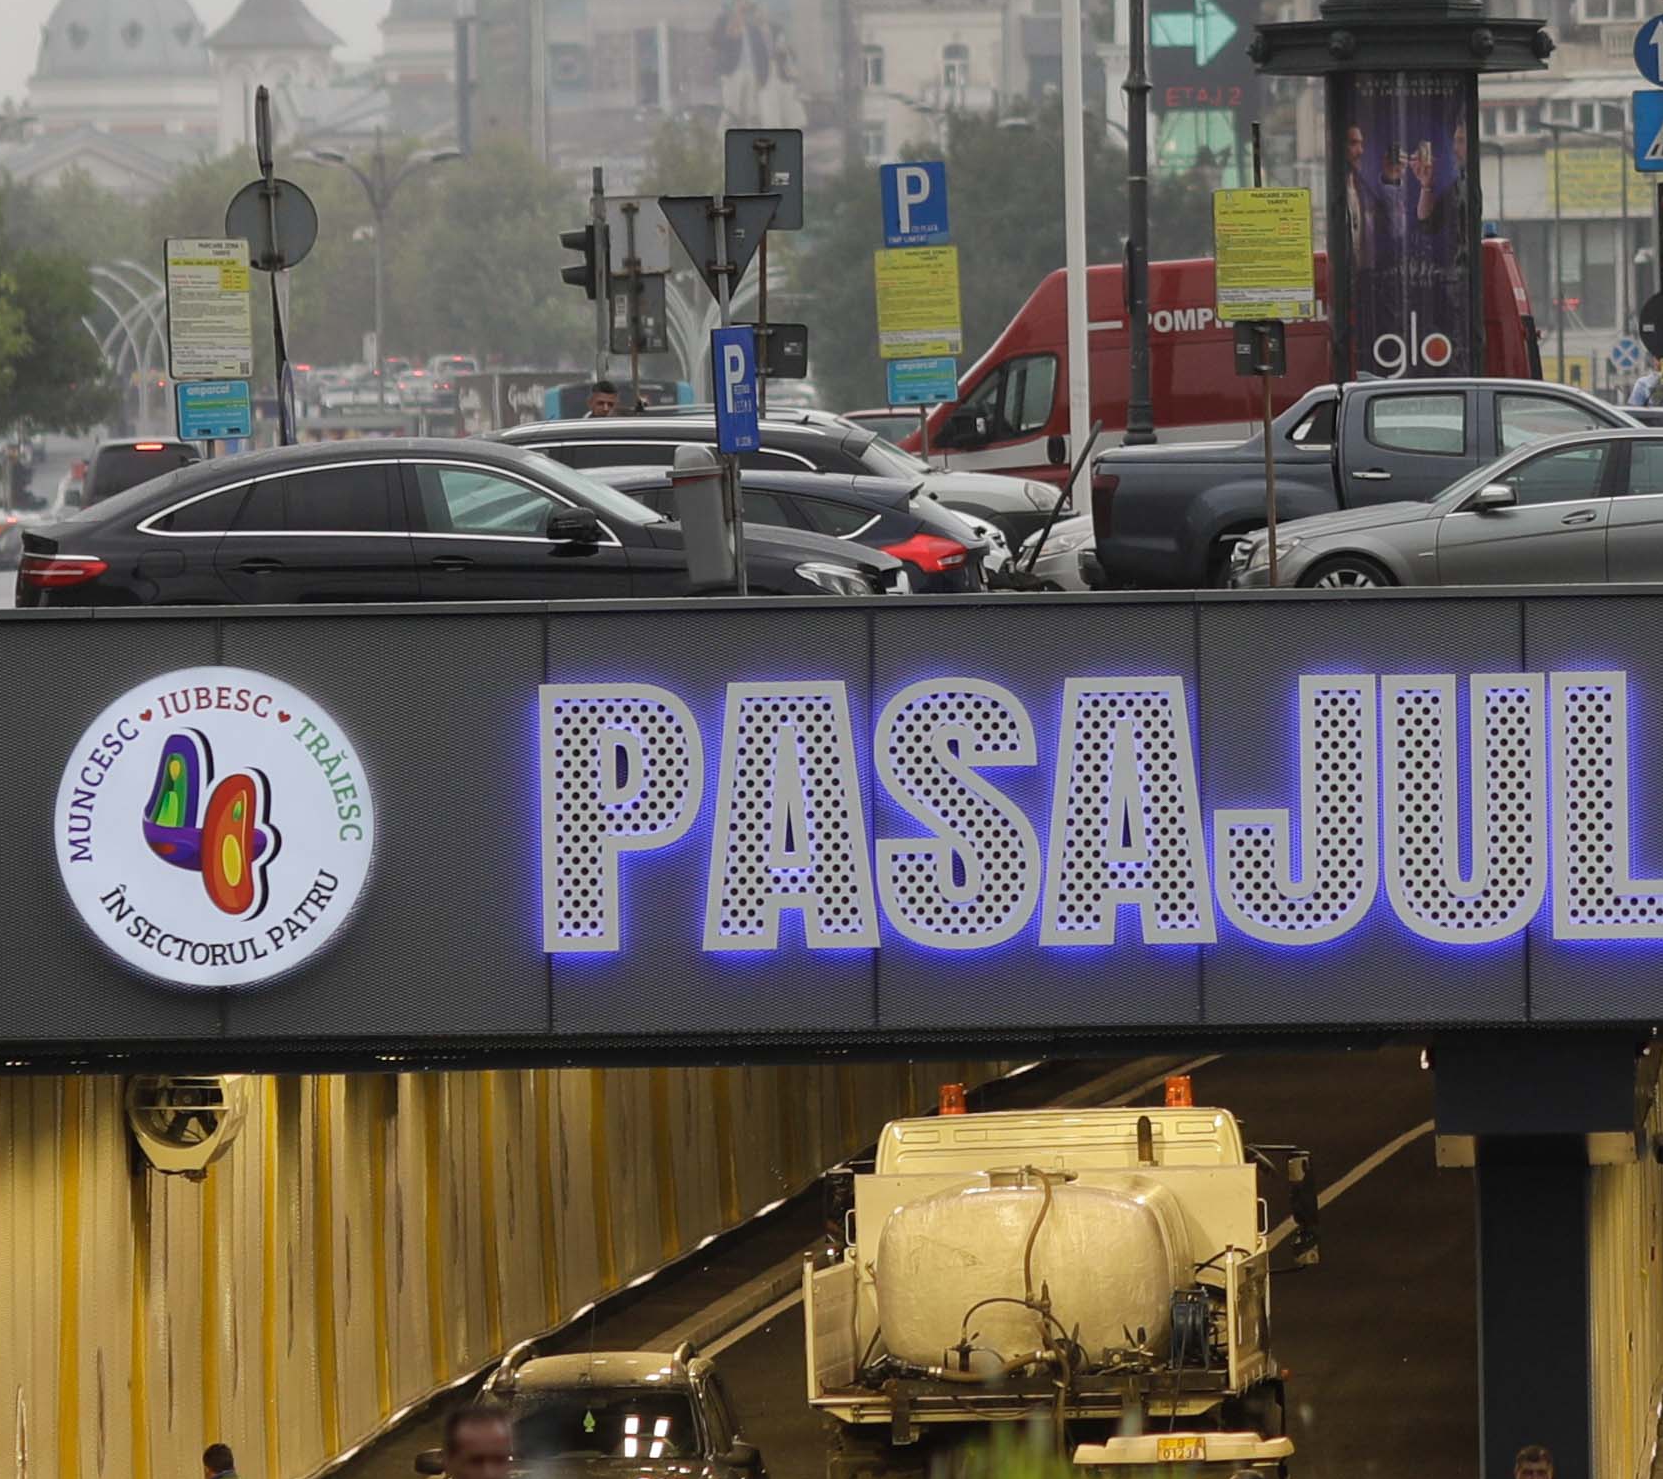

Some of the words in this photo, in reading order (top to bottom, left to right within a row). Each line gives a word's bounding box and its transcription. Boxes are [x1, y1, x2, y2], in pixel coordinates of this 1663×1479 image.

[1229, 86, 1243, 106] 2
[896, 166, 930, 234] P
[723, 344, 745, 413] P
[1373, 311, 1452, 379] glo
[68, 718, 139, 863] MUNCESC
[157, 686, 274, 720] IUBESC
[293, 717, 363, 842] TRĂIESC
[99, 883, 134, 923] ÎN
[126, 915, 268, 967] SECTORUL
[266, 868, 340, 952] PATRU
